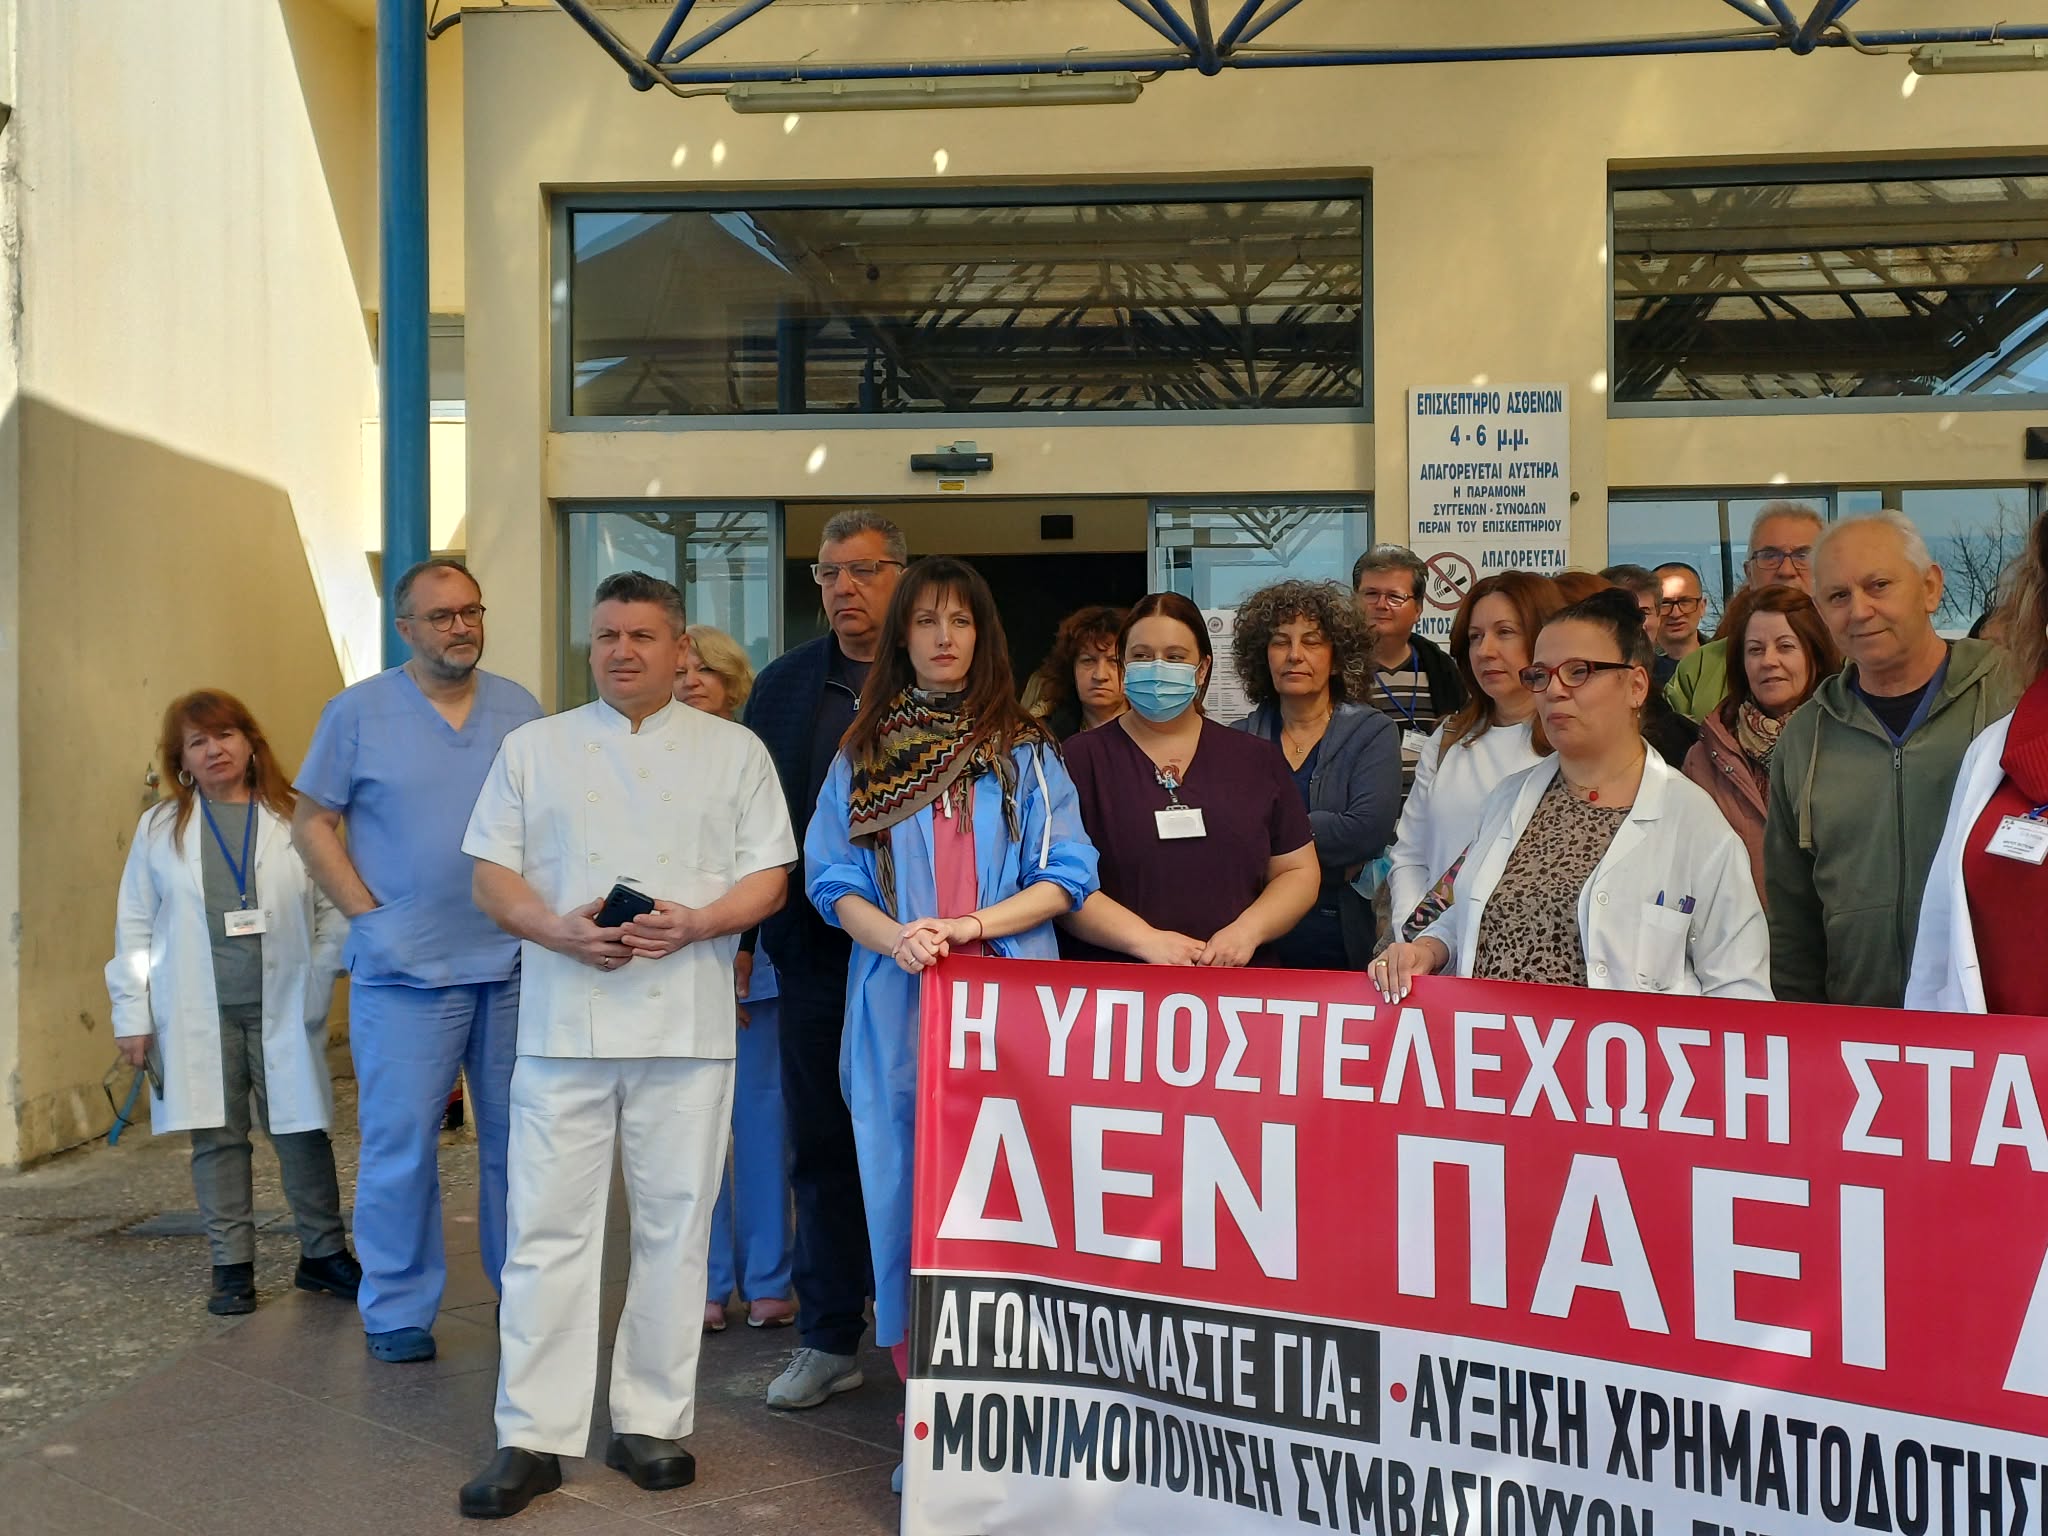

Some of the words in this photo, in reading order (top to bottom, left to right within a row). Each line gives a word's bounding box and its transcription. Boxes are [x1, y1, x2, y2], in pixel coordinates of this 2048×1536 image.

[1417, 392, 1500, 416] ΕΠΙΣΚΕΠΤΗΡΙΟ
[1507, 390, 1563, 414] ΑΣΘΕΝΩΝ
[1450, 425, 1460, 447] 4
[1476, 424, 1486, 446] 6
[1497, 429, 1529, 452] μ.μ.
[1420, 462, 1503, 481] ΑΠΑΓΟΡΕΥΕΤΑΙ
[1508, 461, 1559, 479] ΑΥΣΤΗΡΑ
[1453, 486, 1461, 498] Η
[1467, 485, 1526, 498] ΠΑΡΑΜΟΝΗ
[1433, 502, 1487, 516] ΣΥΓΓΕΝΩΝ
[1495, 502, 1546, 515] ΣΥΝΟΔΩΝ
[1418, 521, 1451, 534] ΠΕΡΑΝ
[1457, 520, 1477, 533] ΤΟΥ
[1482, 520, 1562, 533] ΕΠΙΣΚΕΠΤΗΡΙΟΥ
[1481, 549, 1566, 568] ΑΠΑΓΟΡΕΥΕΤΑΙ
[949, 981, 998, 1071] Η
[1035, 985, 1791, 1145] ΥΠΟΣΤΕΛΕΧΩΣΗ
[936, 1097, 1298, 1281] ΔΕΝ
[1397, 1134, 1887, 1372] ΠΑΕΙ
[931, 1289, 1256, 1409] ΑΓΩΝΙΖΟΜΑΣΤΕ
[1273, 1332, 1362, 1426] ΓΙΑ:
[931, 1391, 1283, 1516] ΜΟΝΙΜΟΠΟΙΗΣΗ
[1410, 1354, 1588, 1469] ΑΥΞΗΣΗ
[1605, 1385, 2048, 1536] ΧΡΗΜΑΤΟΔΟΤΗΣ
